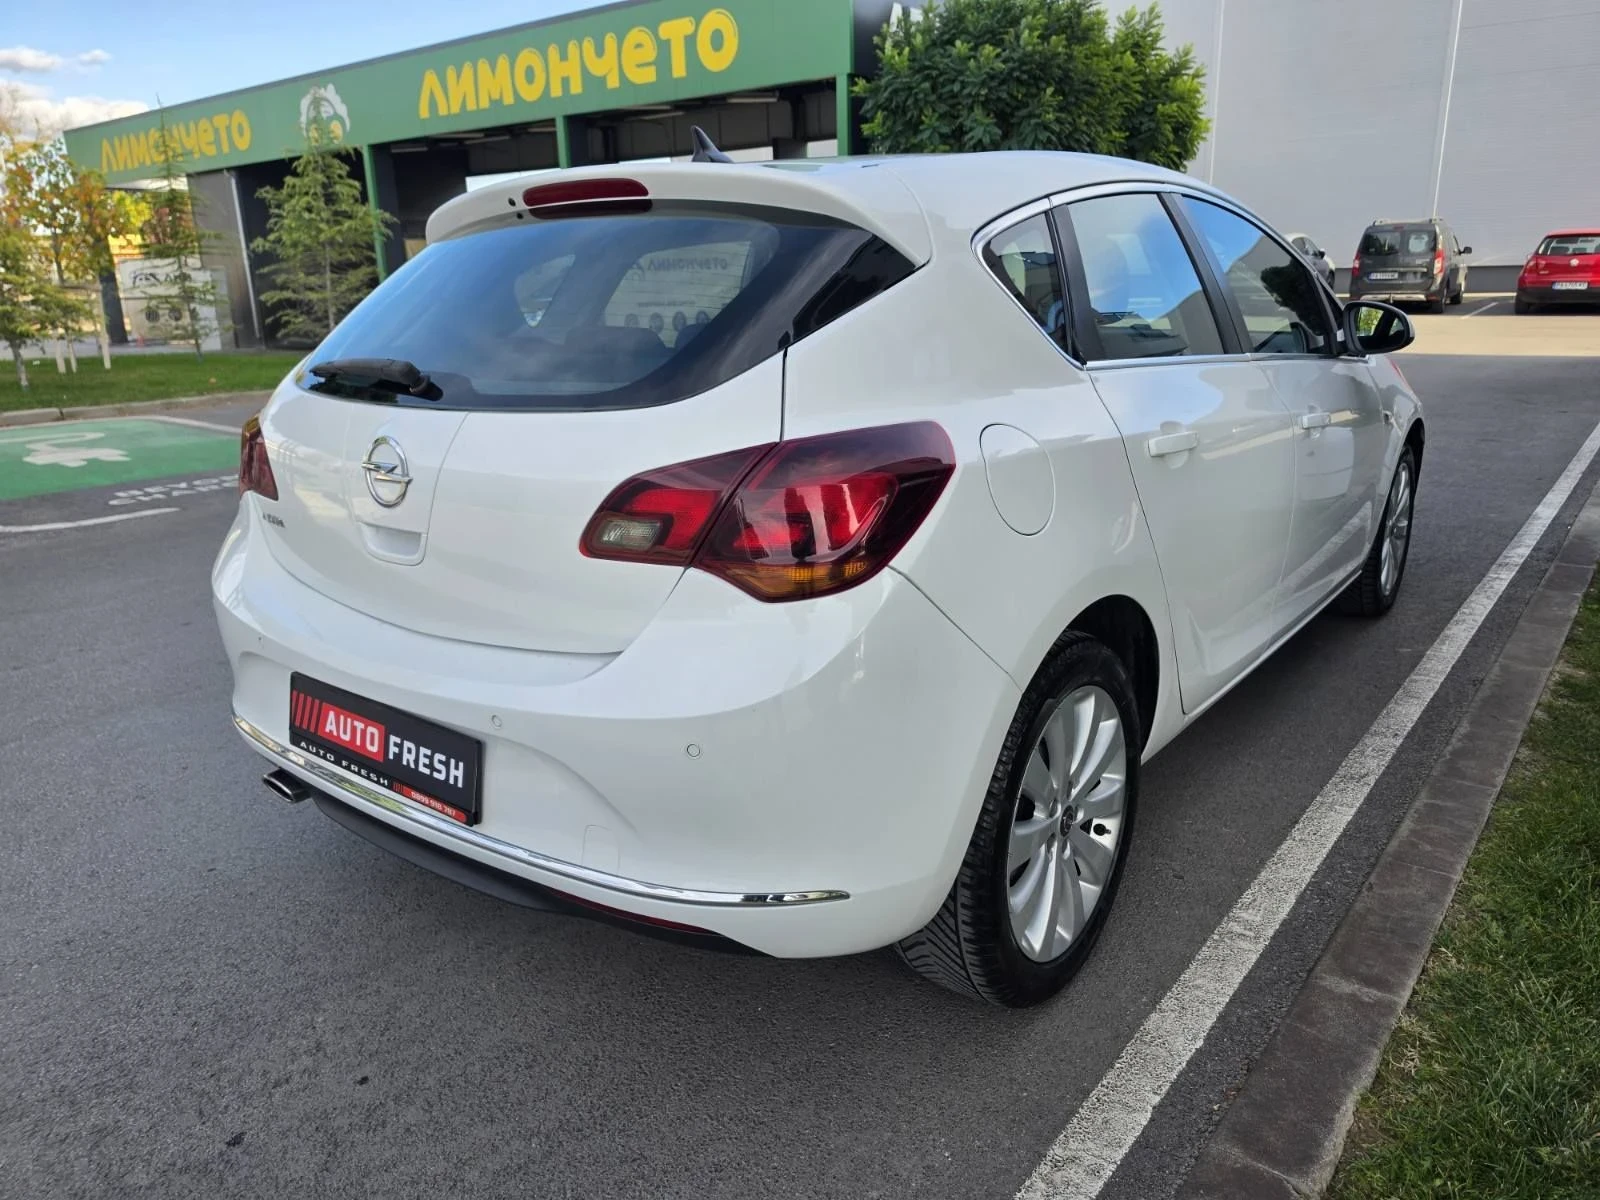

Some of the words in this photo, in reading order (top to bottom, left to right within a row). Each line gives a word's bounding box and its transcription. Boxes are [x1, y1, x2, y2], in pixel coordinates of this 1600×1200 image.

[300, 741, 335, 762] AUTO
[341, 759, 388, 786] FRESH
[325, 710, 379, 753] AUTO
[388, 734, 464, 788] FRESH
